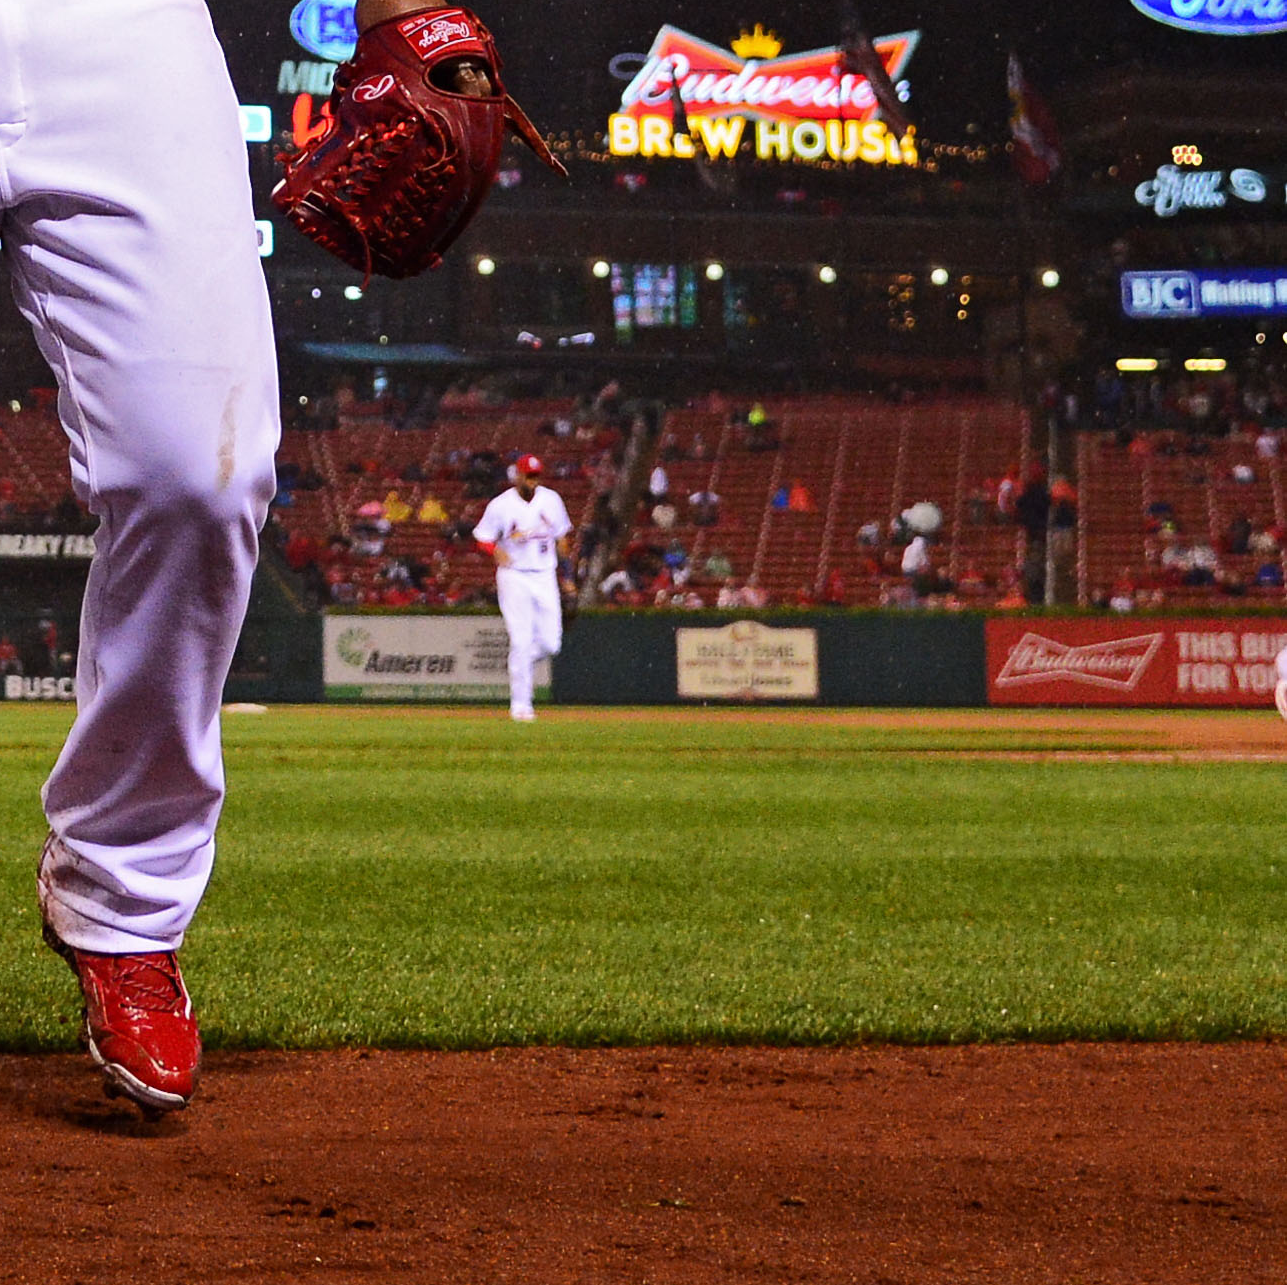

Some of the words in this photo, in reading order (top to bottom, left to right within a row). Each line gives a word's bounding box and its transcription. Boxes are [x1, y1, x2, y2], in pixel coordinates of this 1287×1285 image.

[418, 21, 470, 48] Rawlings
[1132, 277, 1189, 312] BJC
[62, 533, 97, 556] FAS
[365, 649, 457, 674] Ameren
[1010, 643, 1145, 673] Budweiser
[4, 675, 77, 700] BUSC
[1177, 662, 1232, 692] FOR
